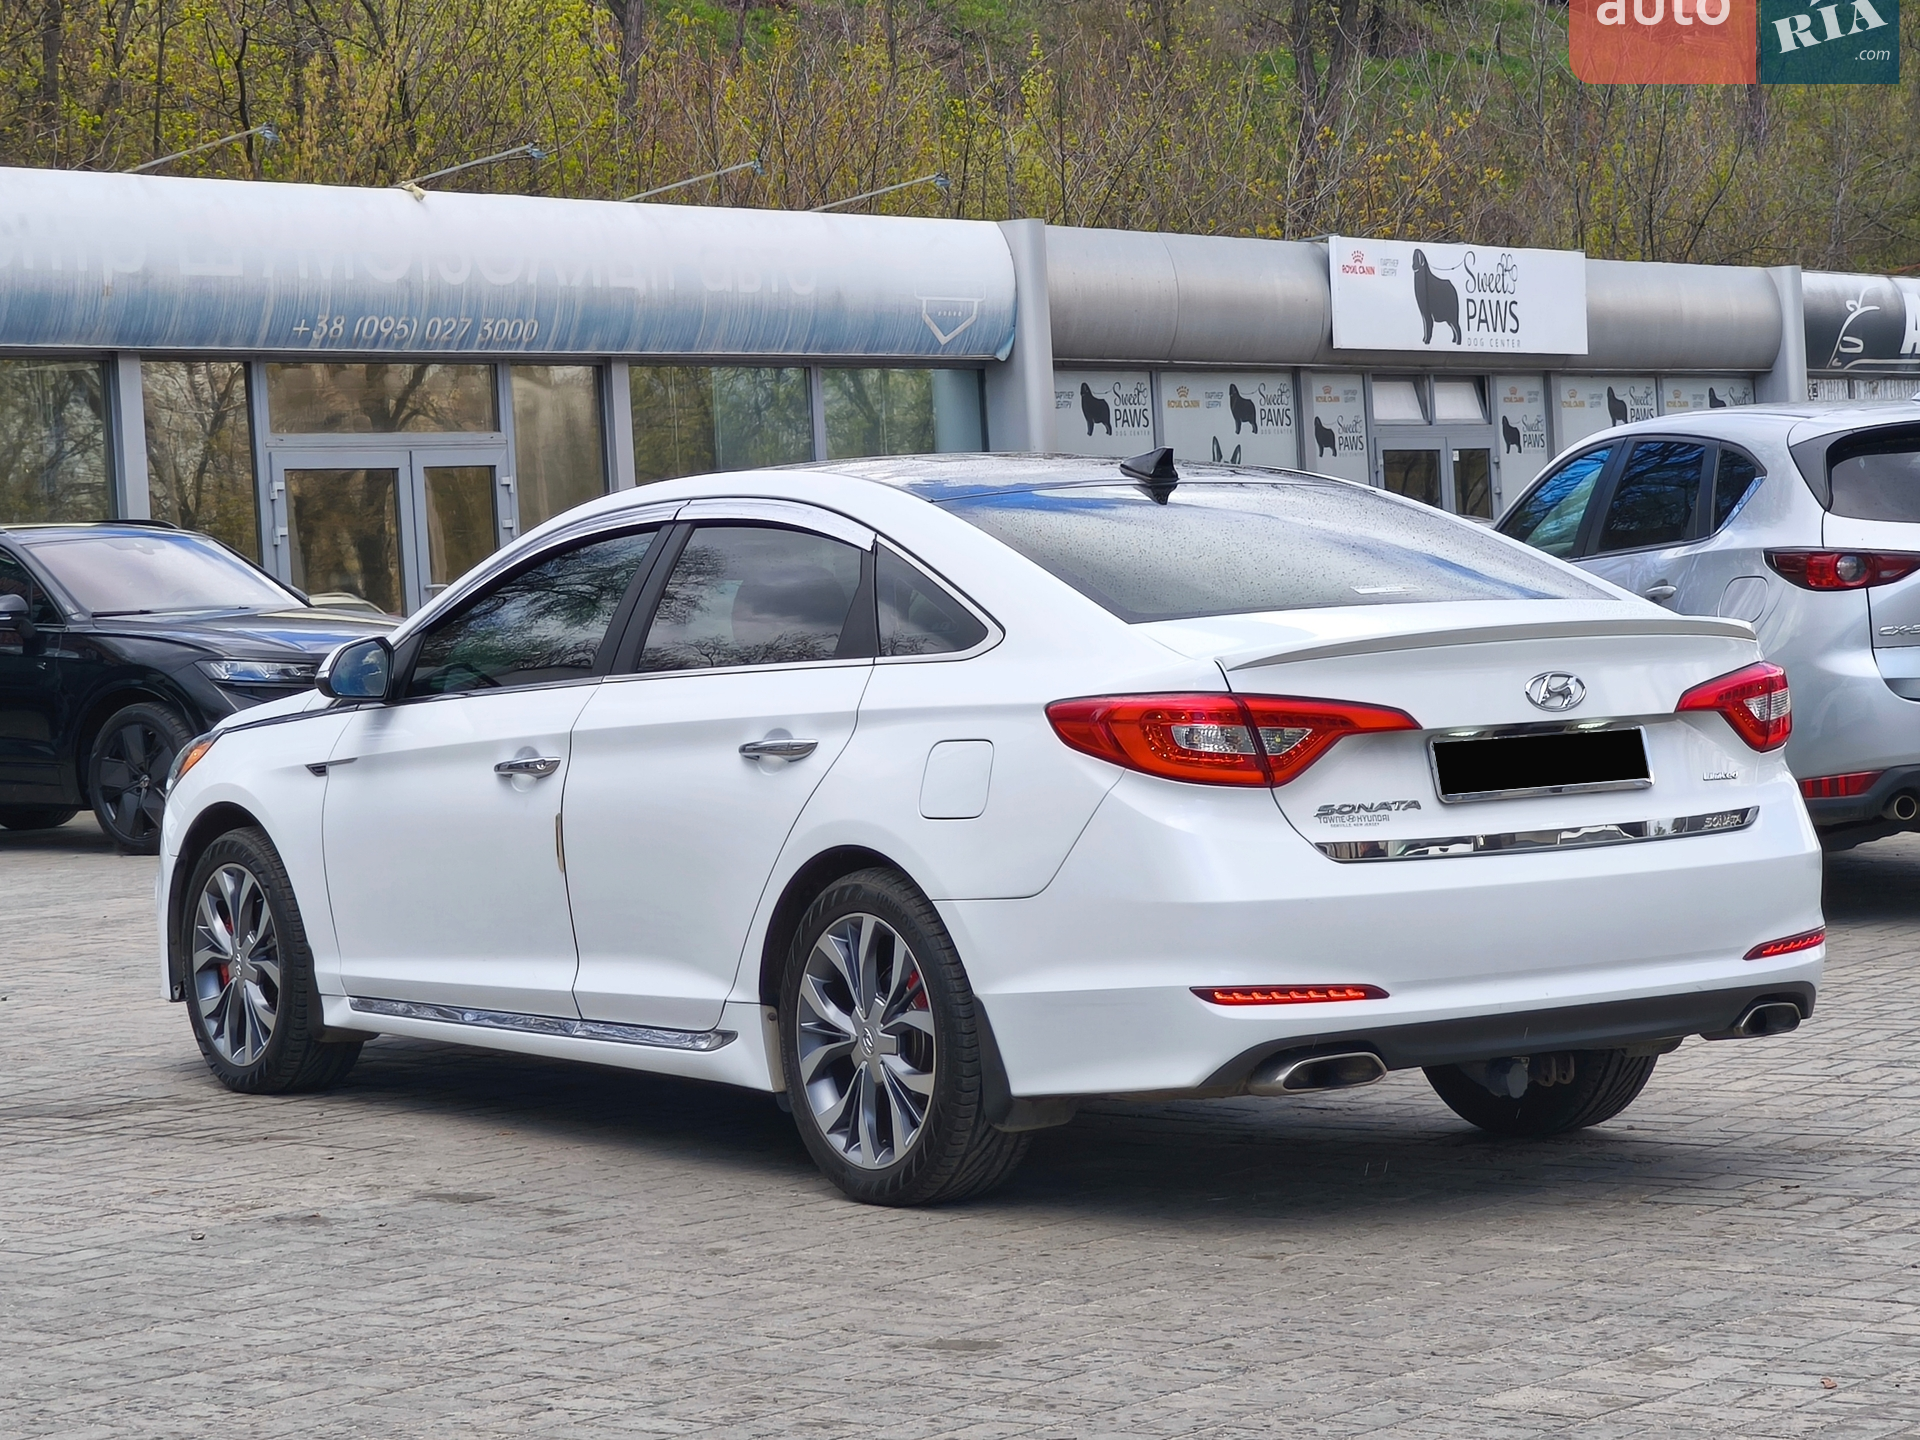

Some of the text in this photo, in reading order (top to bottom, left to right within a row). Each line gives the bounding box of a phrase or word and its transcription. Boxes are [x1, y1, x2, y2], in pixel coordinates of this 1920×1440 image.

[1463, 250, 1511, 294] Sweet
[1466, 298, 1520, 334] PAWS
[293, 314, 540, 344] +38 (095) 027 3000
[1467, 337, 1521, 348] DOG CENTER
[1112, 381, 1144, 407] Sweet
[1258, 382, 1286, 406] Sweet
[1629, 385, 1650, 407] Sweet
[1114, 408, 1150, 428] PAWS
[1260, 408, 1292, 427] PAWS
[1337, 414, 1360, 435] Sweet
[1521, 414, 1542, 433] Sweet
[1630, 408, 1655, 423] PAWS
[1338, 435, 1365, 451] PAWS
[1522, 433, 1546, 448] PAWS
[1313, 800, 1422, 817] SONATA
[1318, 814, 1390, 824] TOWNE HYUNDAI
